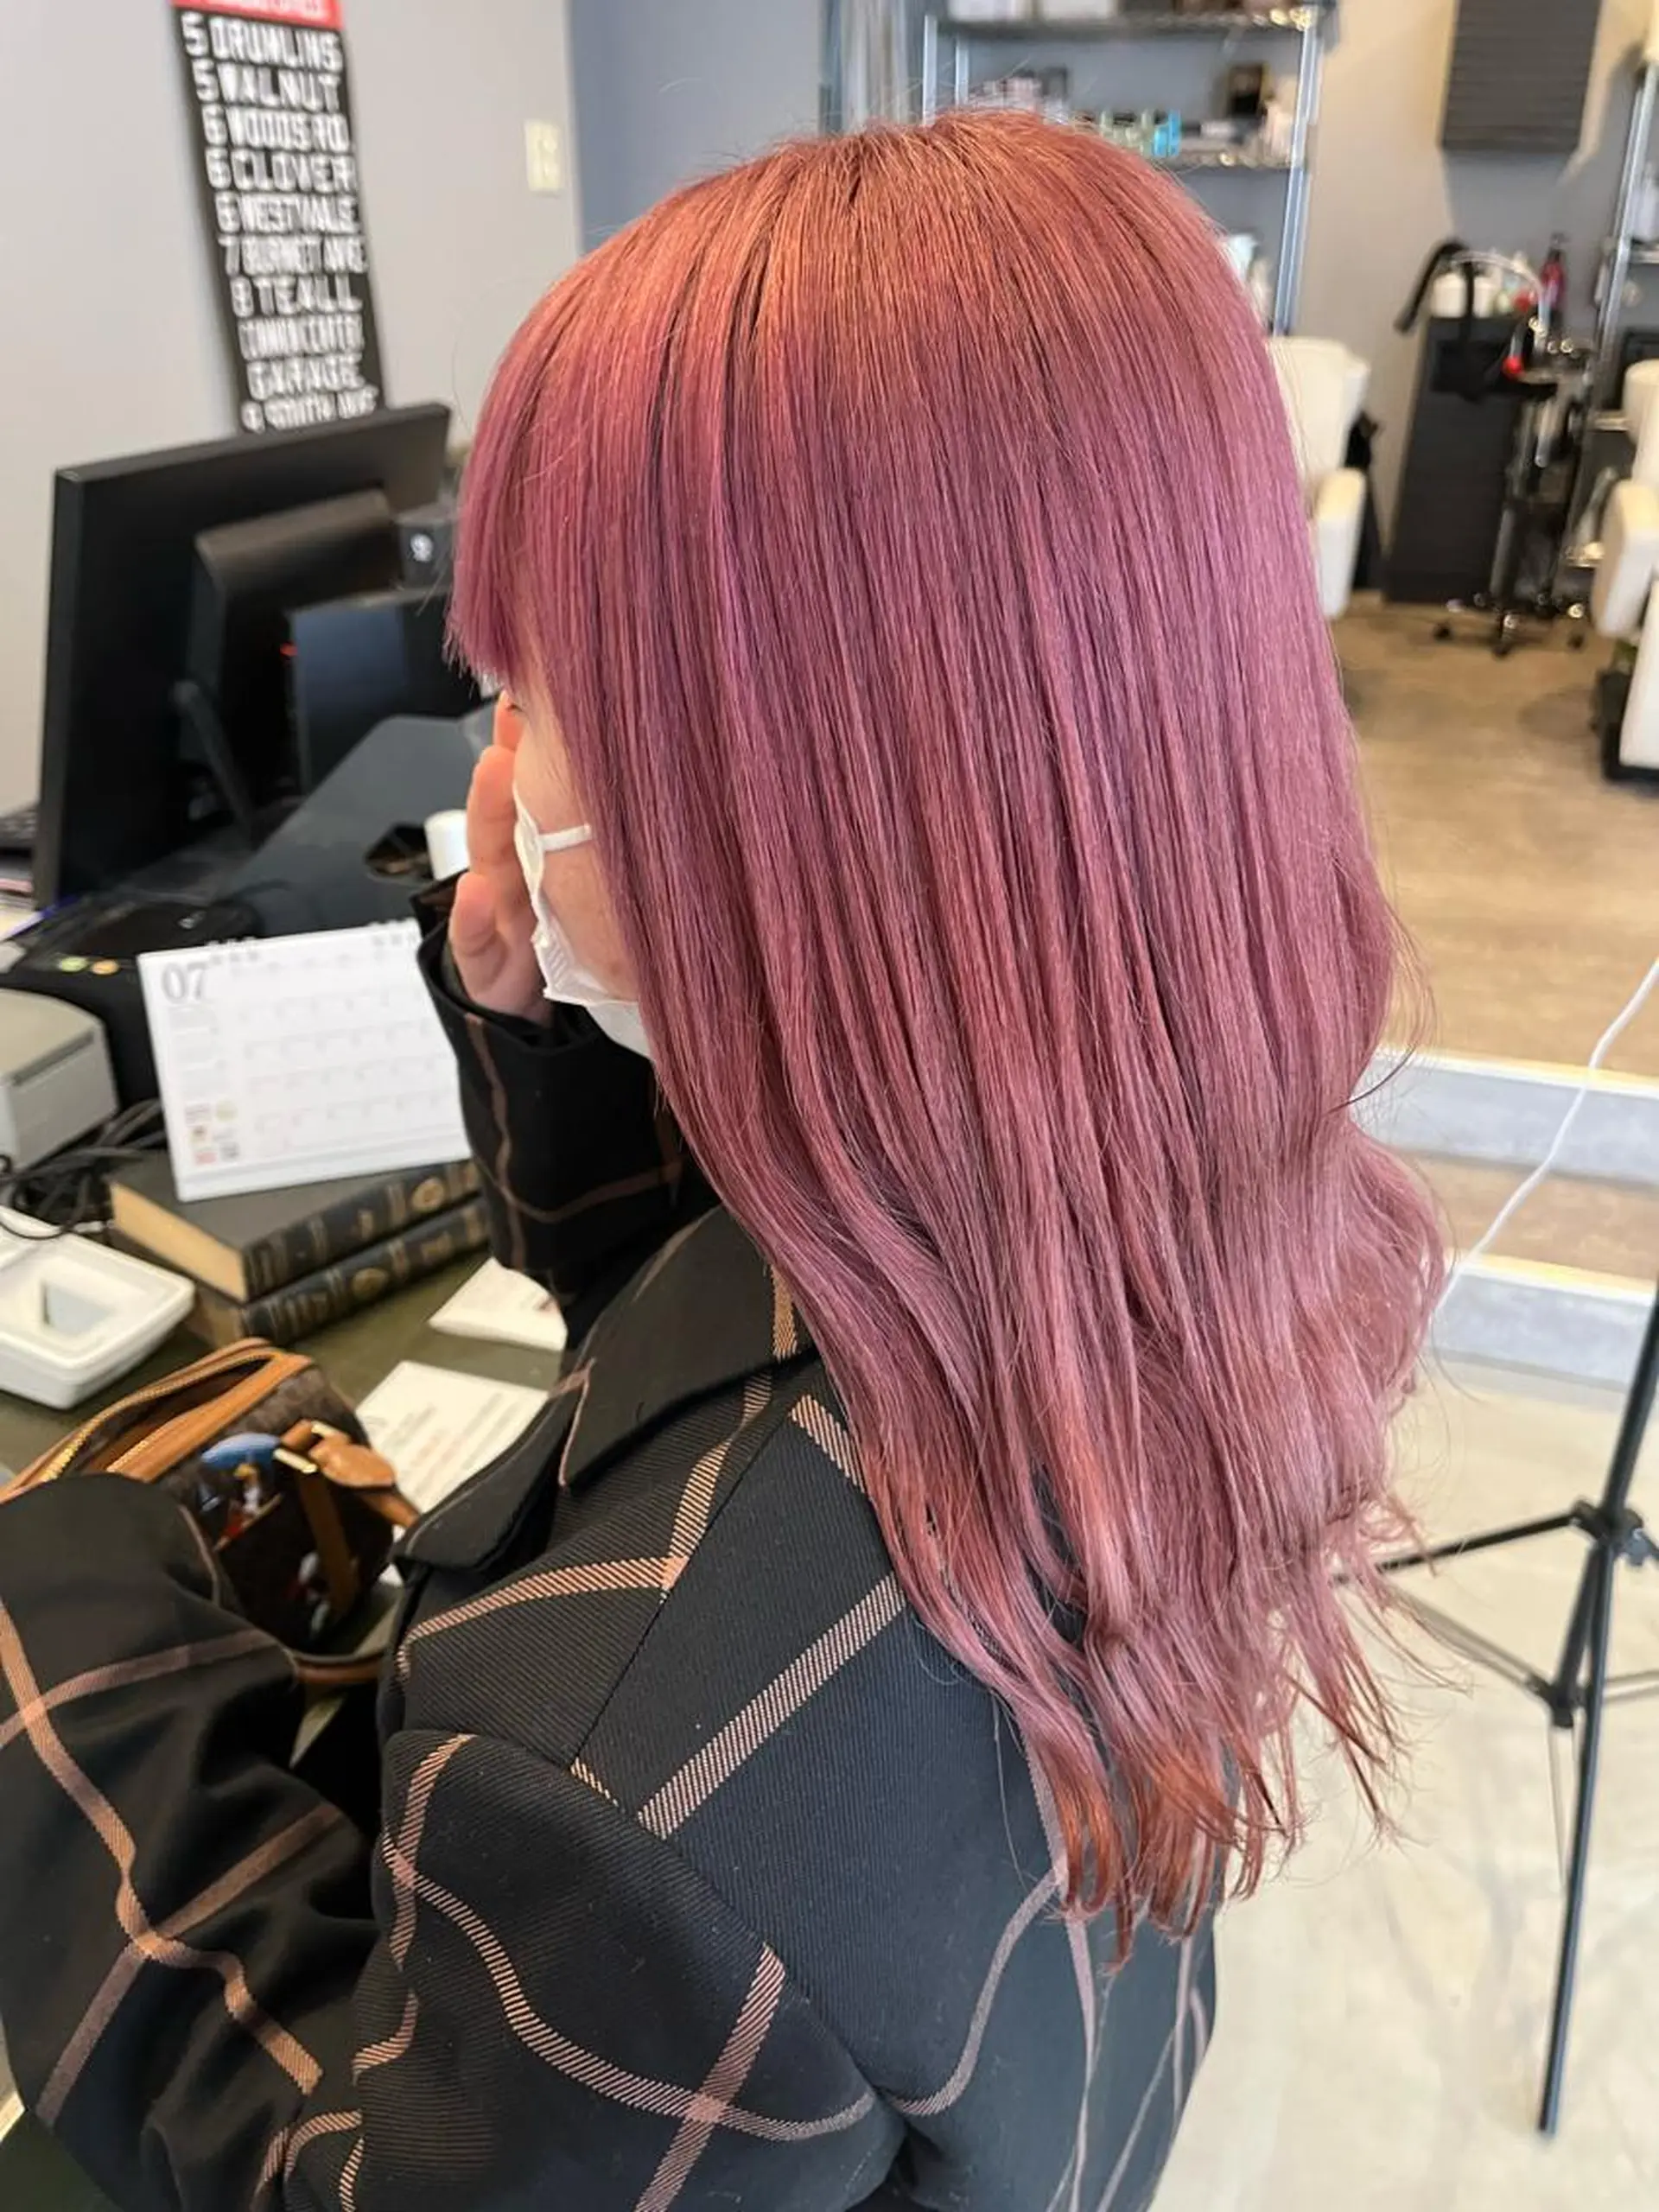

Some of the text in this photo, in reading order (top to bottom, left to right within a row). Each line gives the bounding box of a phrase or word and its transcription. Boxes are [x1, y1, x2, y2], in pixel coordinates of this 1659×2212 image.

[181, 11, 209, 56] 5
[192, 58, 340, 112] 5 WALNUT
[201, 104, 227, 147] 6
[231, 148, 358, 194] CLOVER
[162, 961, 208, 1003] 07
